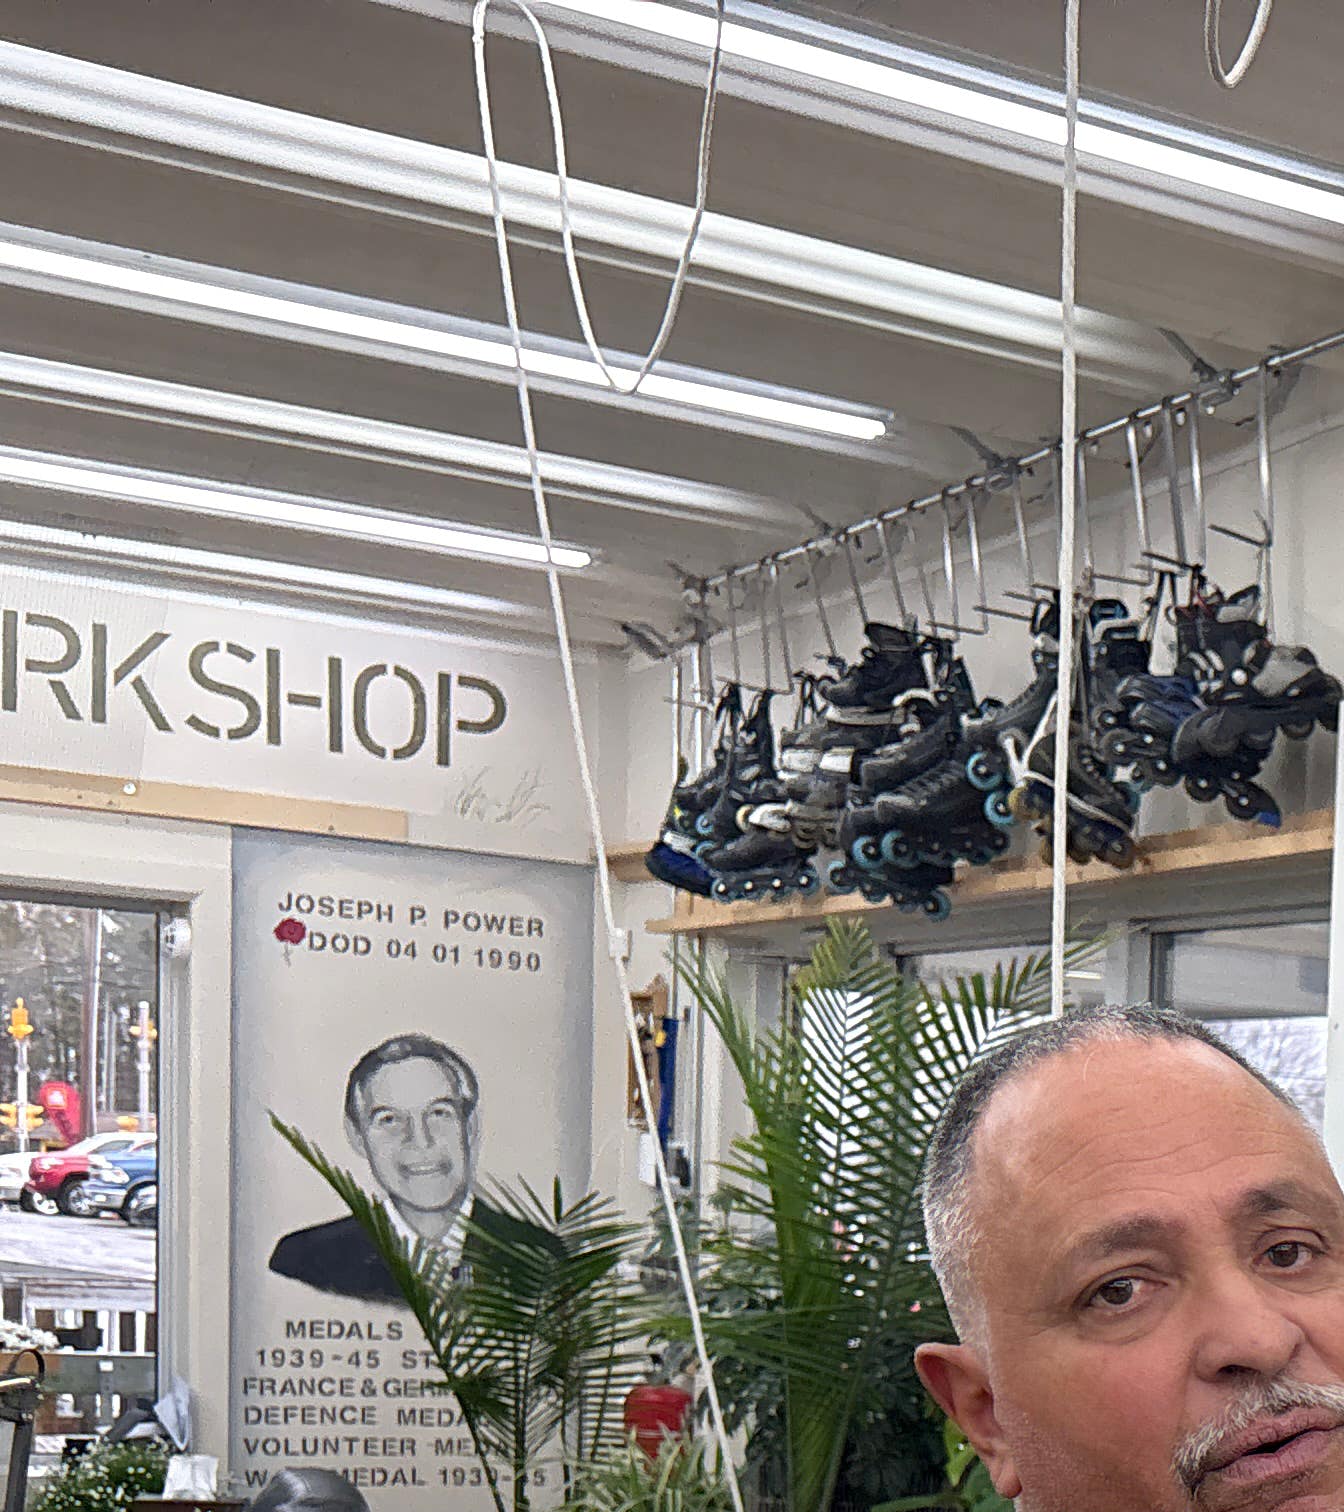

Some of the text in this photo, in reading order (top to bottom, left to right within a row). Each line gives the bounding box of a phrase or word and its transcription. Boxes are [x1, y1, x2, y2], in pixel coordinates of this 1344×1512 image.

[0, 609, 507, 767] RKSHOP
[278, 891, 394, 924] JOSEPH
[443, 909, 545, 938] POWER
[307, 931, 542, 973] DOD 04 01 1990
[285, 1319, 403, 1341] MEDALS
[242, 1376, 355, 1398] FRANCE
[243, 1405, 470, 1428] DEFENCE MEDA
[243, 1436, 416, 1457] VOLUNTEER
